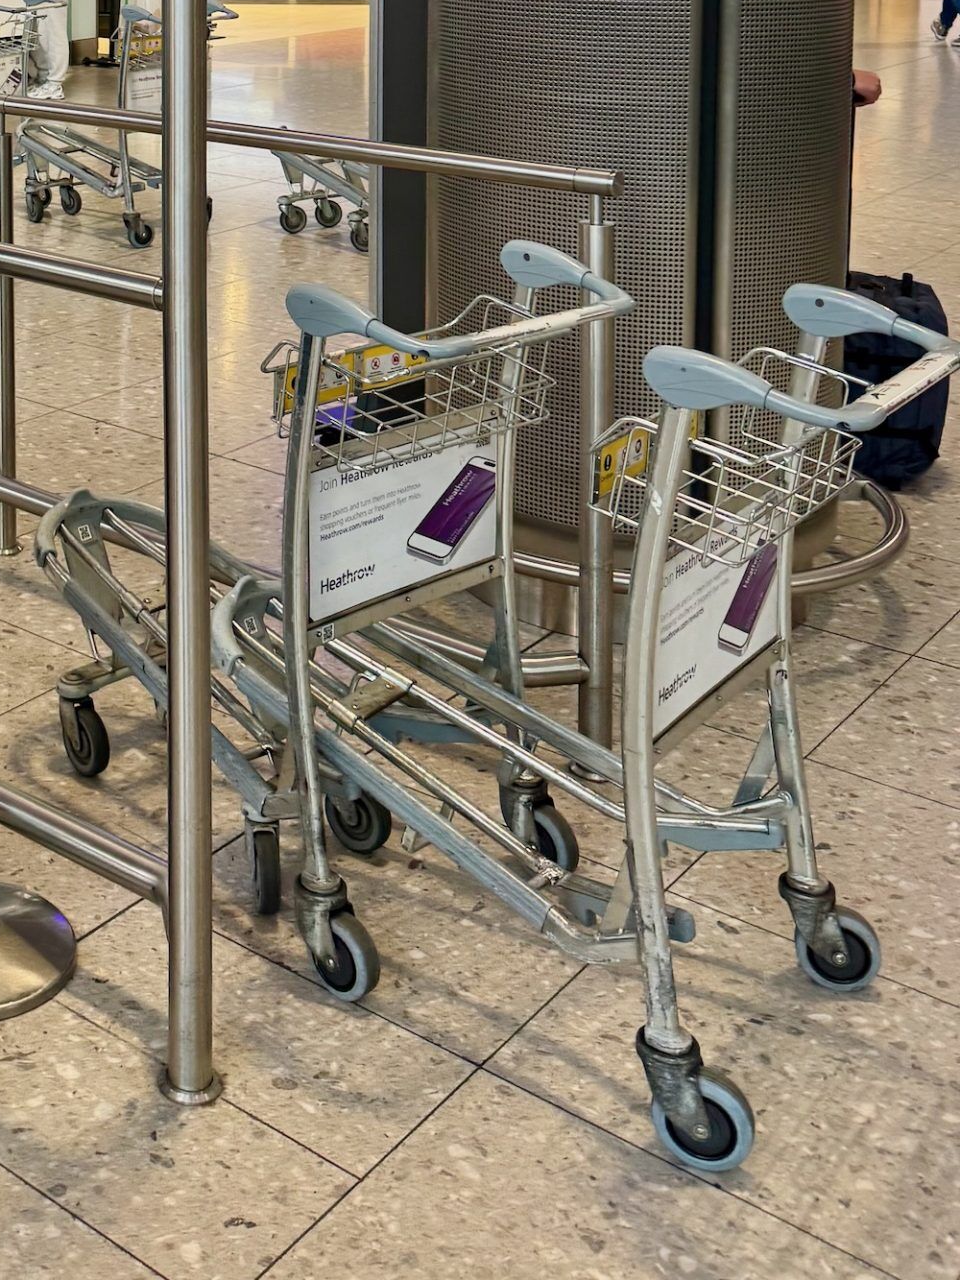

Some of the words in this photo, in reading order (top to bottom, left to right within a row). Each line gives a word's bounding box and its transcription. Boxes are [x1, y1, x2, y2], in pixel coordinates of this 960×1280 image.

[320, 478, 338, 493] Join
[320, 563, 377, 594] Heathrow
[658, 663, 698, 707] Heathrow
